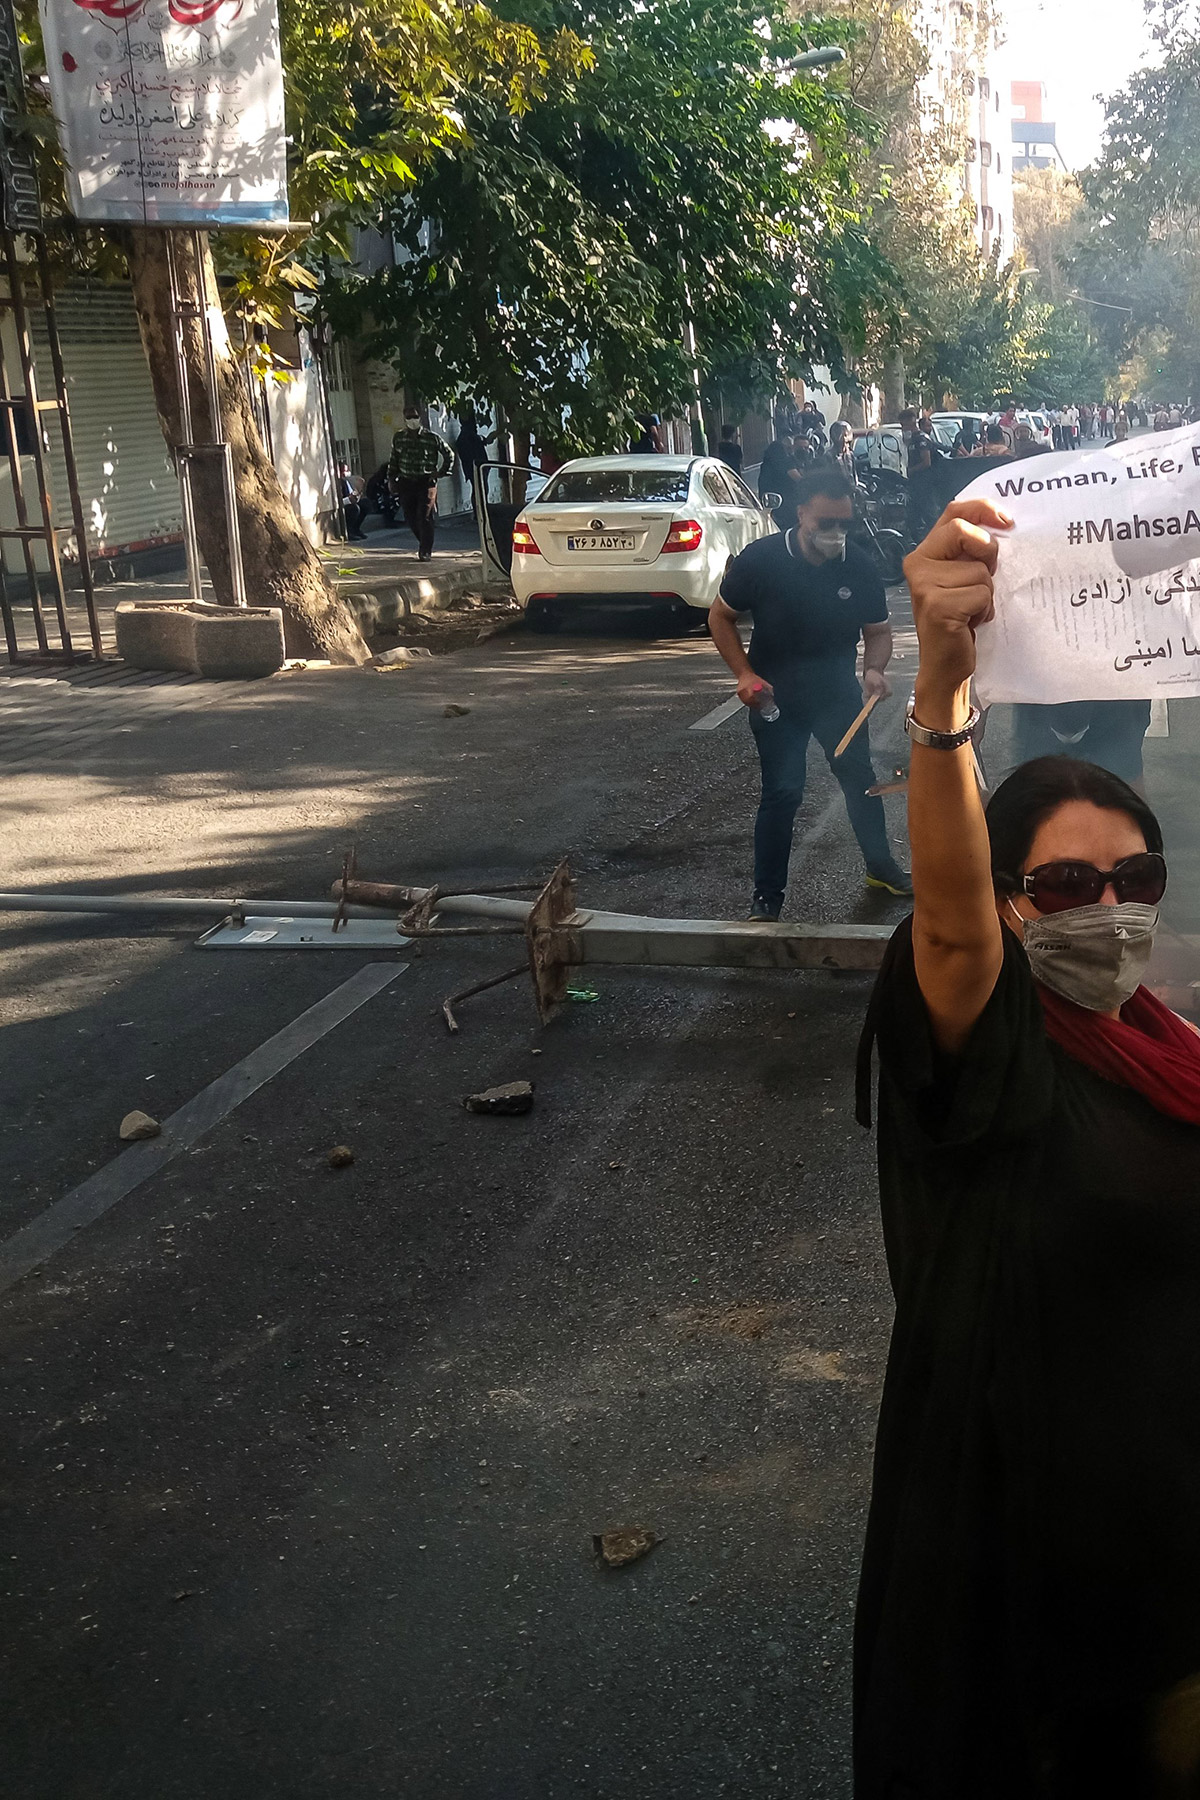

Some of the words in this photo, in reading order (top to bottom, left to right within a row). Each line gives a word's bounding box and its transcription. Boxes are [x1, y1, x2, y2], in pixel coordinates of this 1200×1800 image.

[132, 72, 169, 98] حسین
[995, 468, 1118, 498] Woman,
[1126, 457, 1184, 480] Life,
[1114, 637, 1173, 672] امینی
